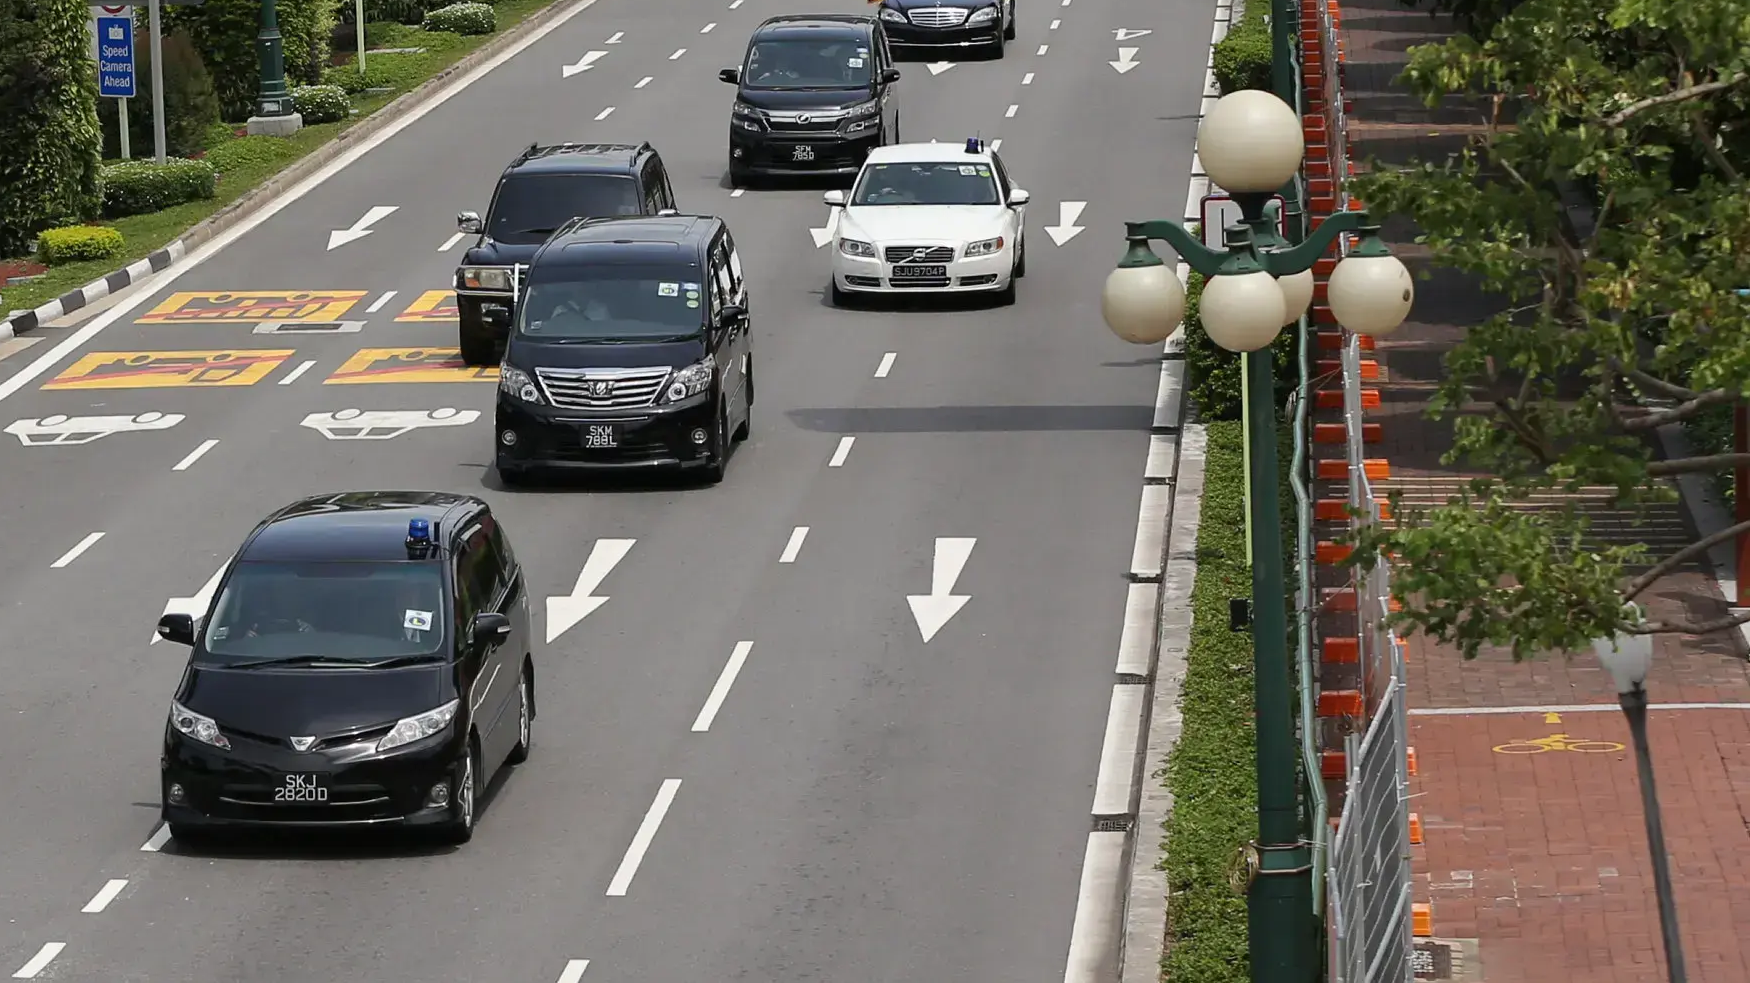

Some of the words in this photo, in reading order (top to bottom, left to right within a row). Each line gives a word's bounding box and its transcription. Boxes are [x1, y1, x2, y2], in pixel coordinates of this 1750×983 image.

[102, 45, 128, 58] Speed
[100, 60, 132, 72] Camera
[104, 75, 130, 87] Ahead
[590, 425, 612, 436] SKM
[586, 435, 617, 445] 788L
[286, 774, 316, 788] SKJ
[275, 787, 327, 801] 2820D
